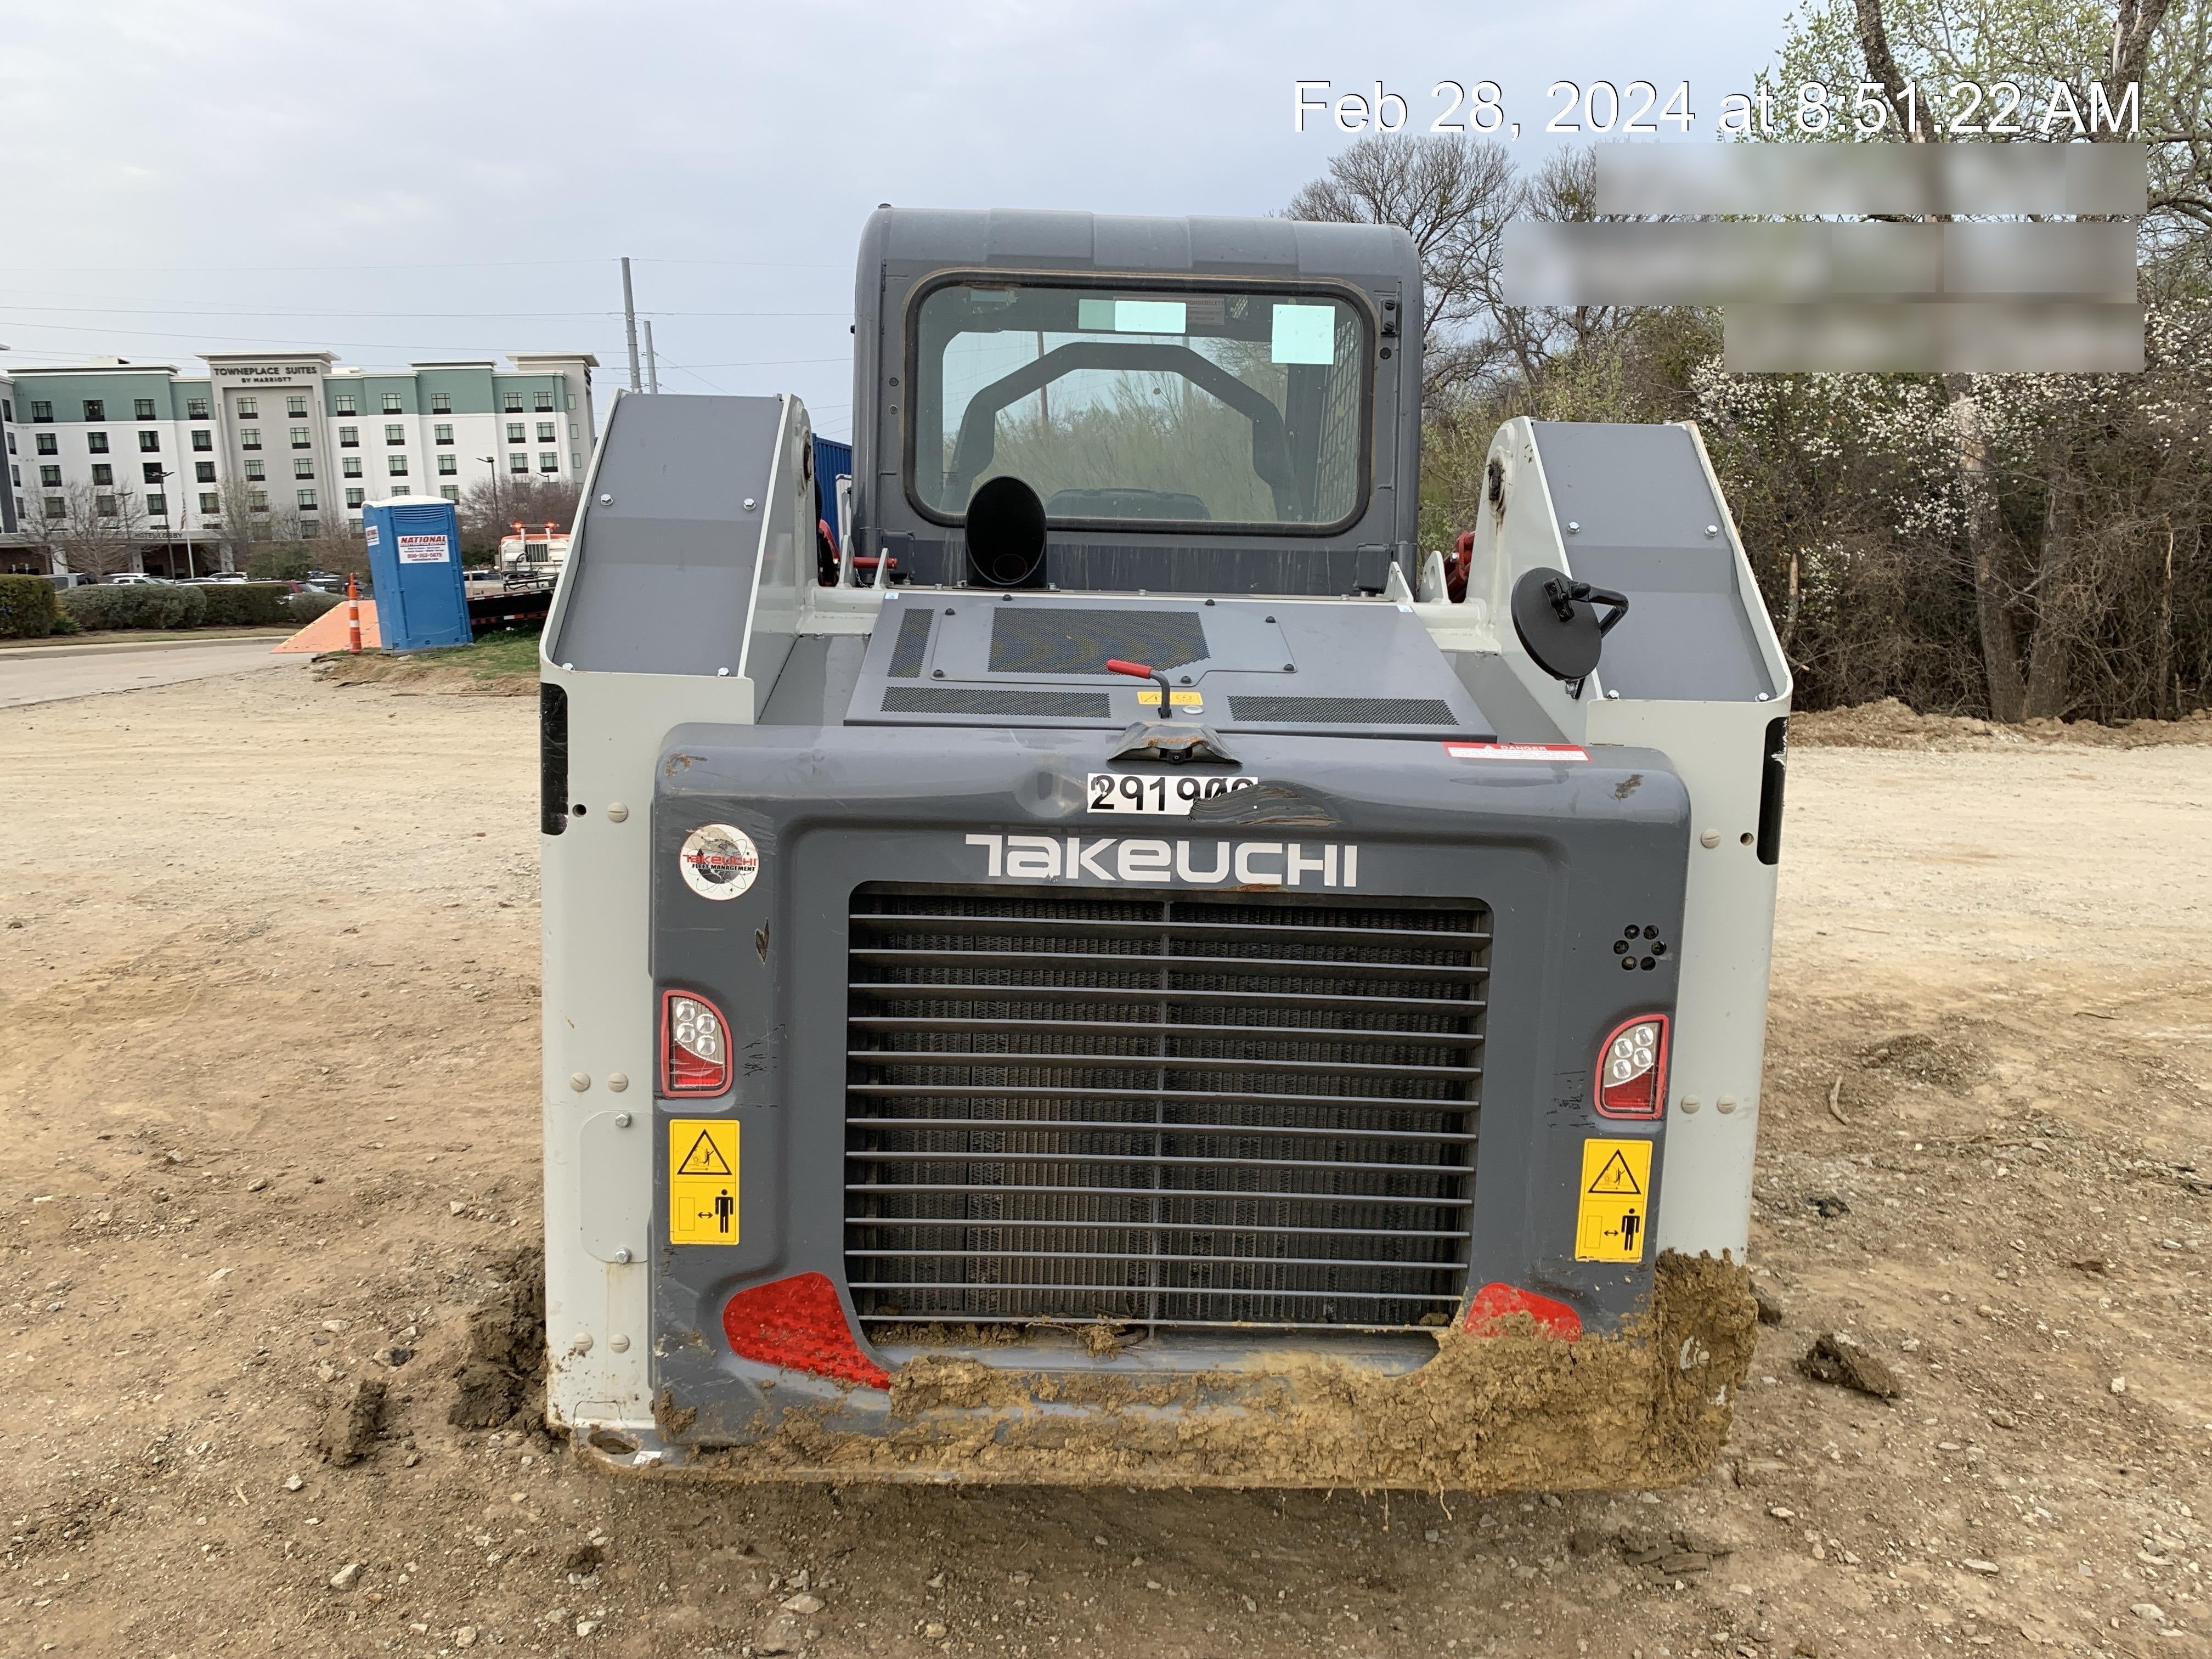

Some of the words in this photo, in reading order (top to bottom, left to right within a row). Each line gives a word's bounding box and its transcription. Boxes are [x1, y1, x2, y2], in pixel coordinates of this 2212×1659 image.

[213, 366, 280, 376] TOWNEPLACE
[285, 366, 317, 375] SUITES
[682, 854, 758, 866] TAKEUCHI
[965, 833, 1358, 888] TAKEUCHI
